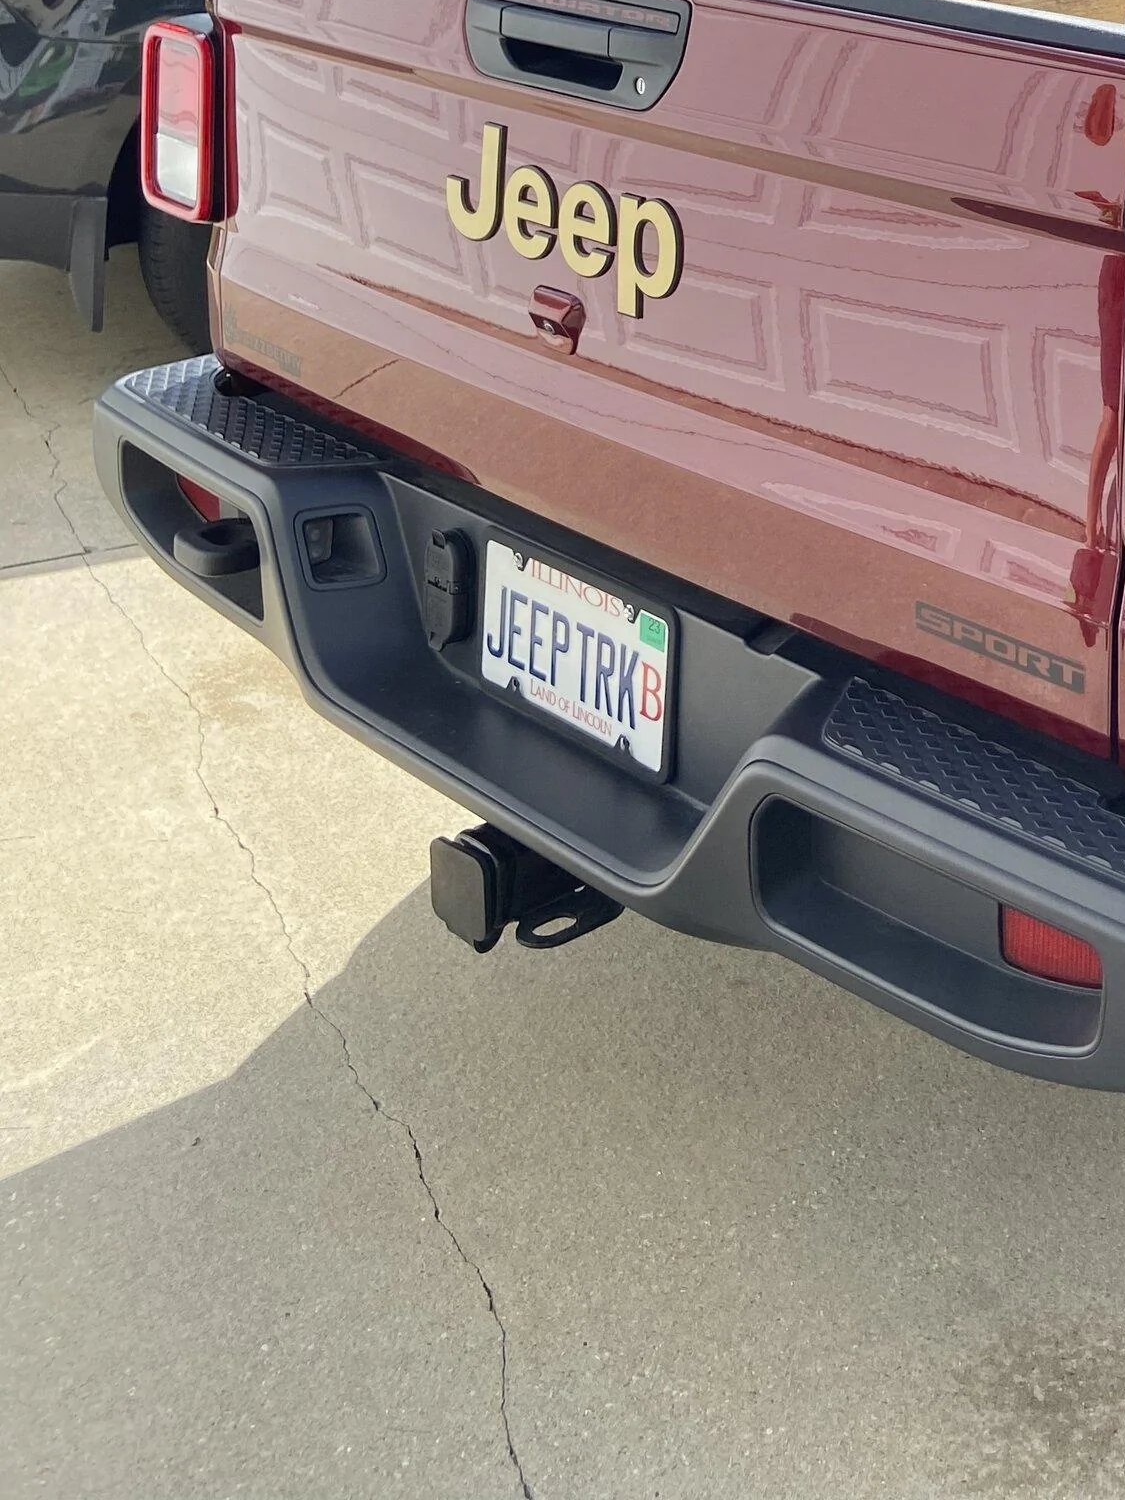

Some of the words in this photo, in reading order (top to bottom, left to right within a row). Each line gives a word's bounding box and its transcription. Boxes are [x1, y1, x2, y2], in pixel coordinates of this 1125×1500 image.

[446, 121, 684, 319] Jeep
[531, 560, 621, 617] ILLINOIS
[648, 617, 661, 635] 23
[917, 606, 1085, 685] SPORT
[529, 678, 557, 706] LAND
[558, 697, 570, 713] OF
[572, 700, 613, 737] LINCOLN
